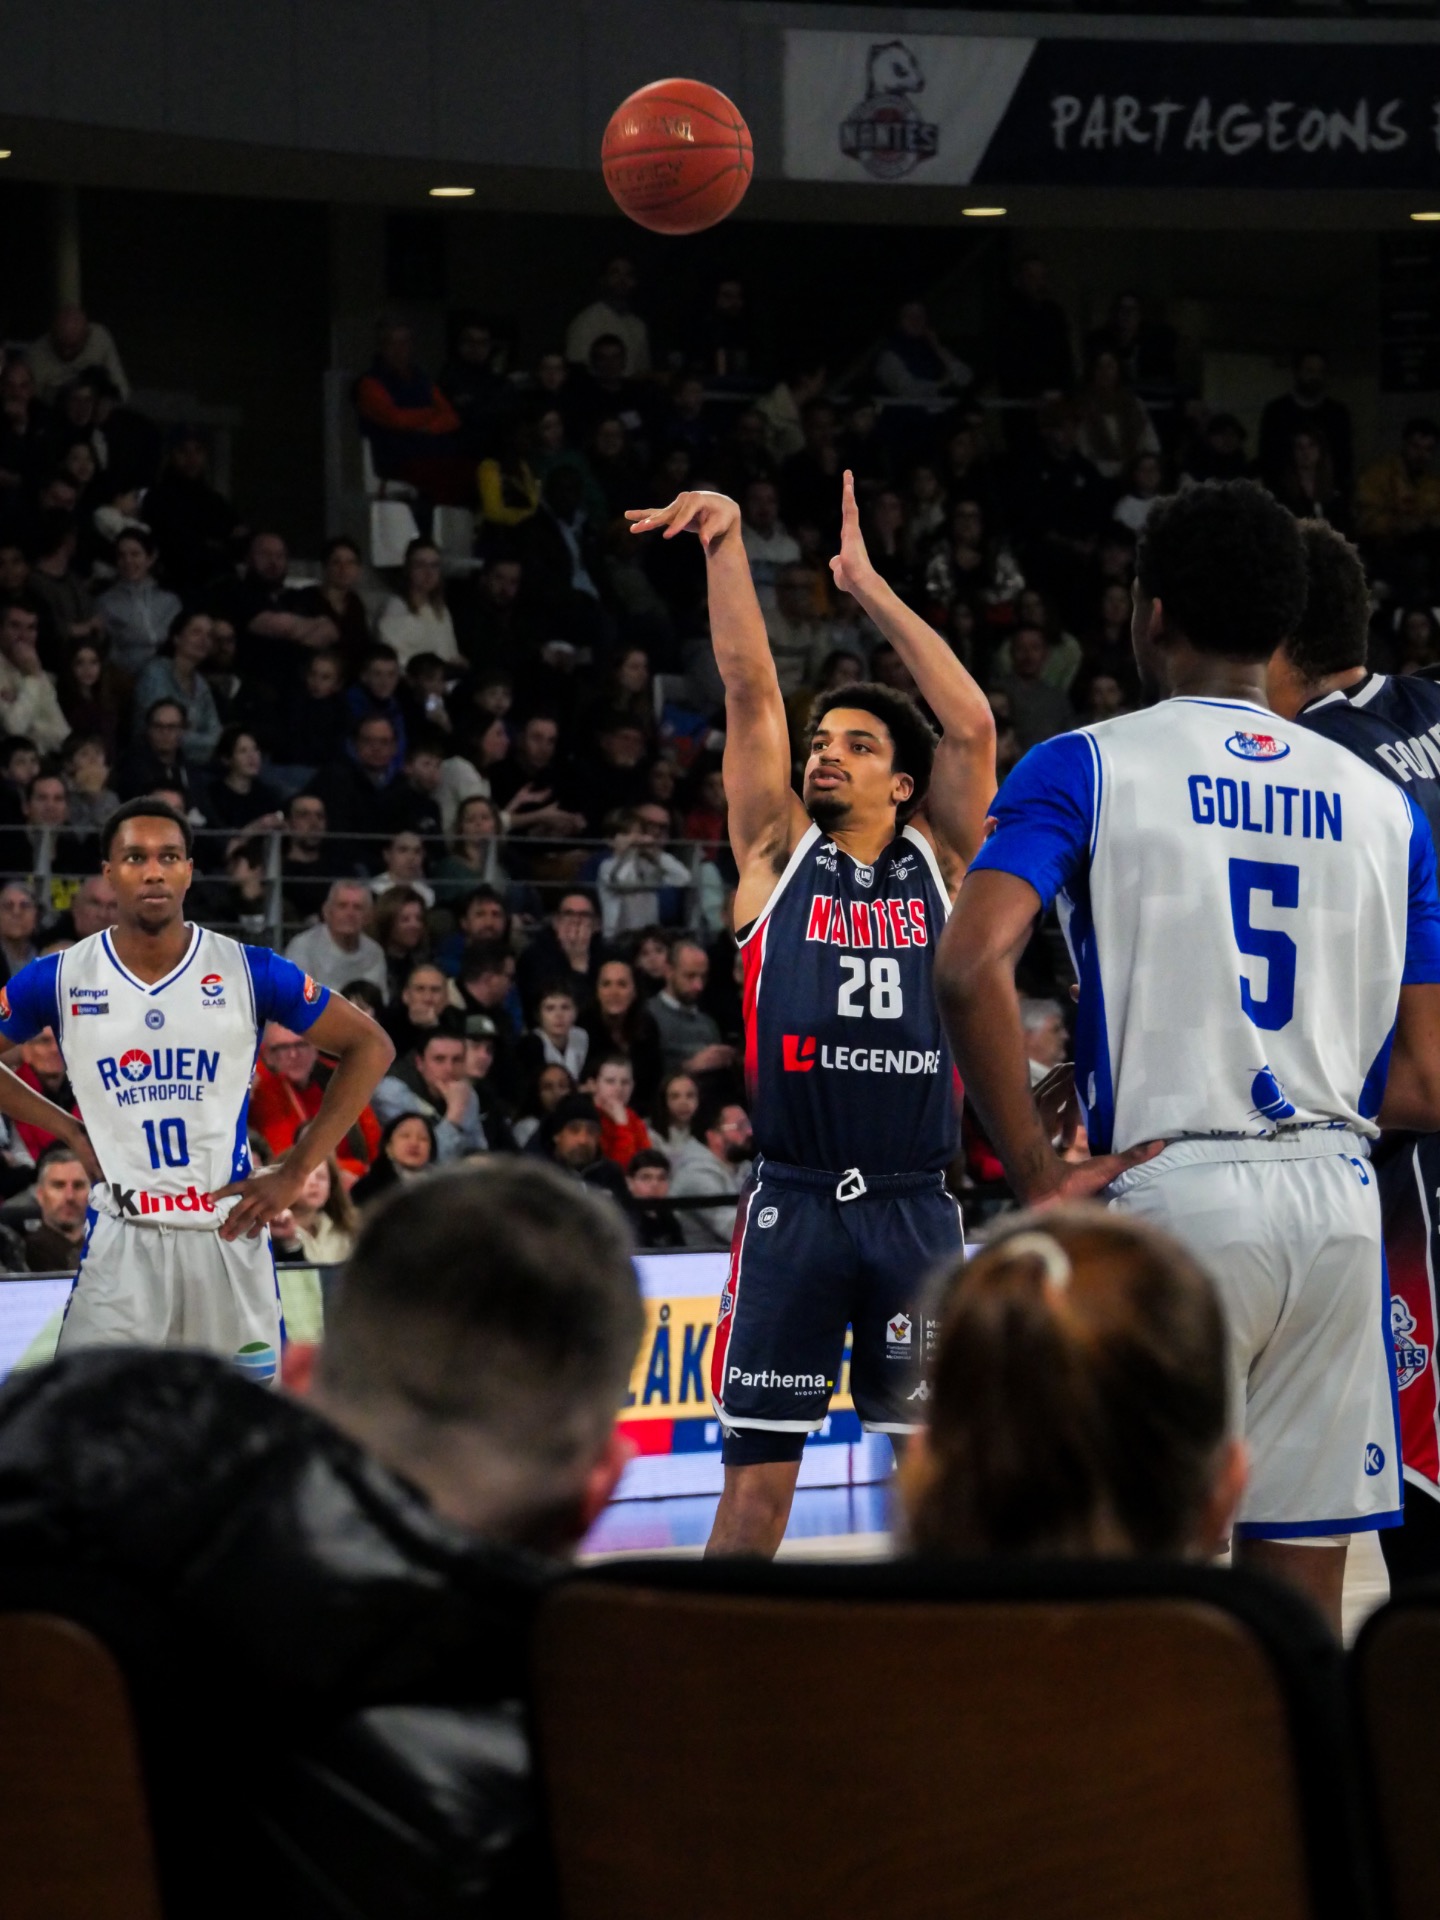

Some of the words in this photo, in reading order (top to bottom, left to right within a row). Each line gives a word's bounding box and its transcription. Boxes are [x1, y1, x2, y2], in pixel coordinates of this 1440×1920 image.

[1051, 95, 1407, 154] PARTAGEONS
[1187, 774, 1342, 841] GOLITIN
[805, 894, 928, 948] NANTES
[1228, 857, 1300, 1031] 5
[69, 987, 108, 1000] Kempa
[837, 955, 903, 1019] 28
[821, 1045, 940, 1074] LEGENDRE
[116, 1084, 205, 1107] MÉTROPOLE
[142, 1117, 190, 1169] 10
